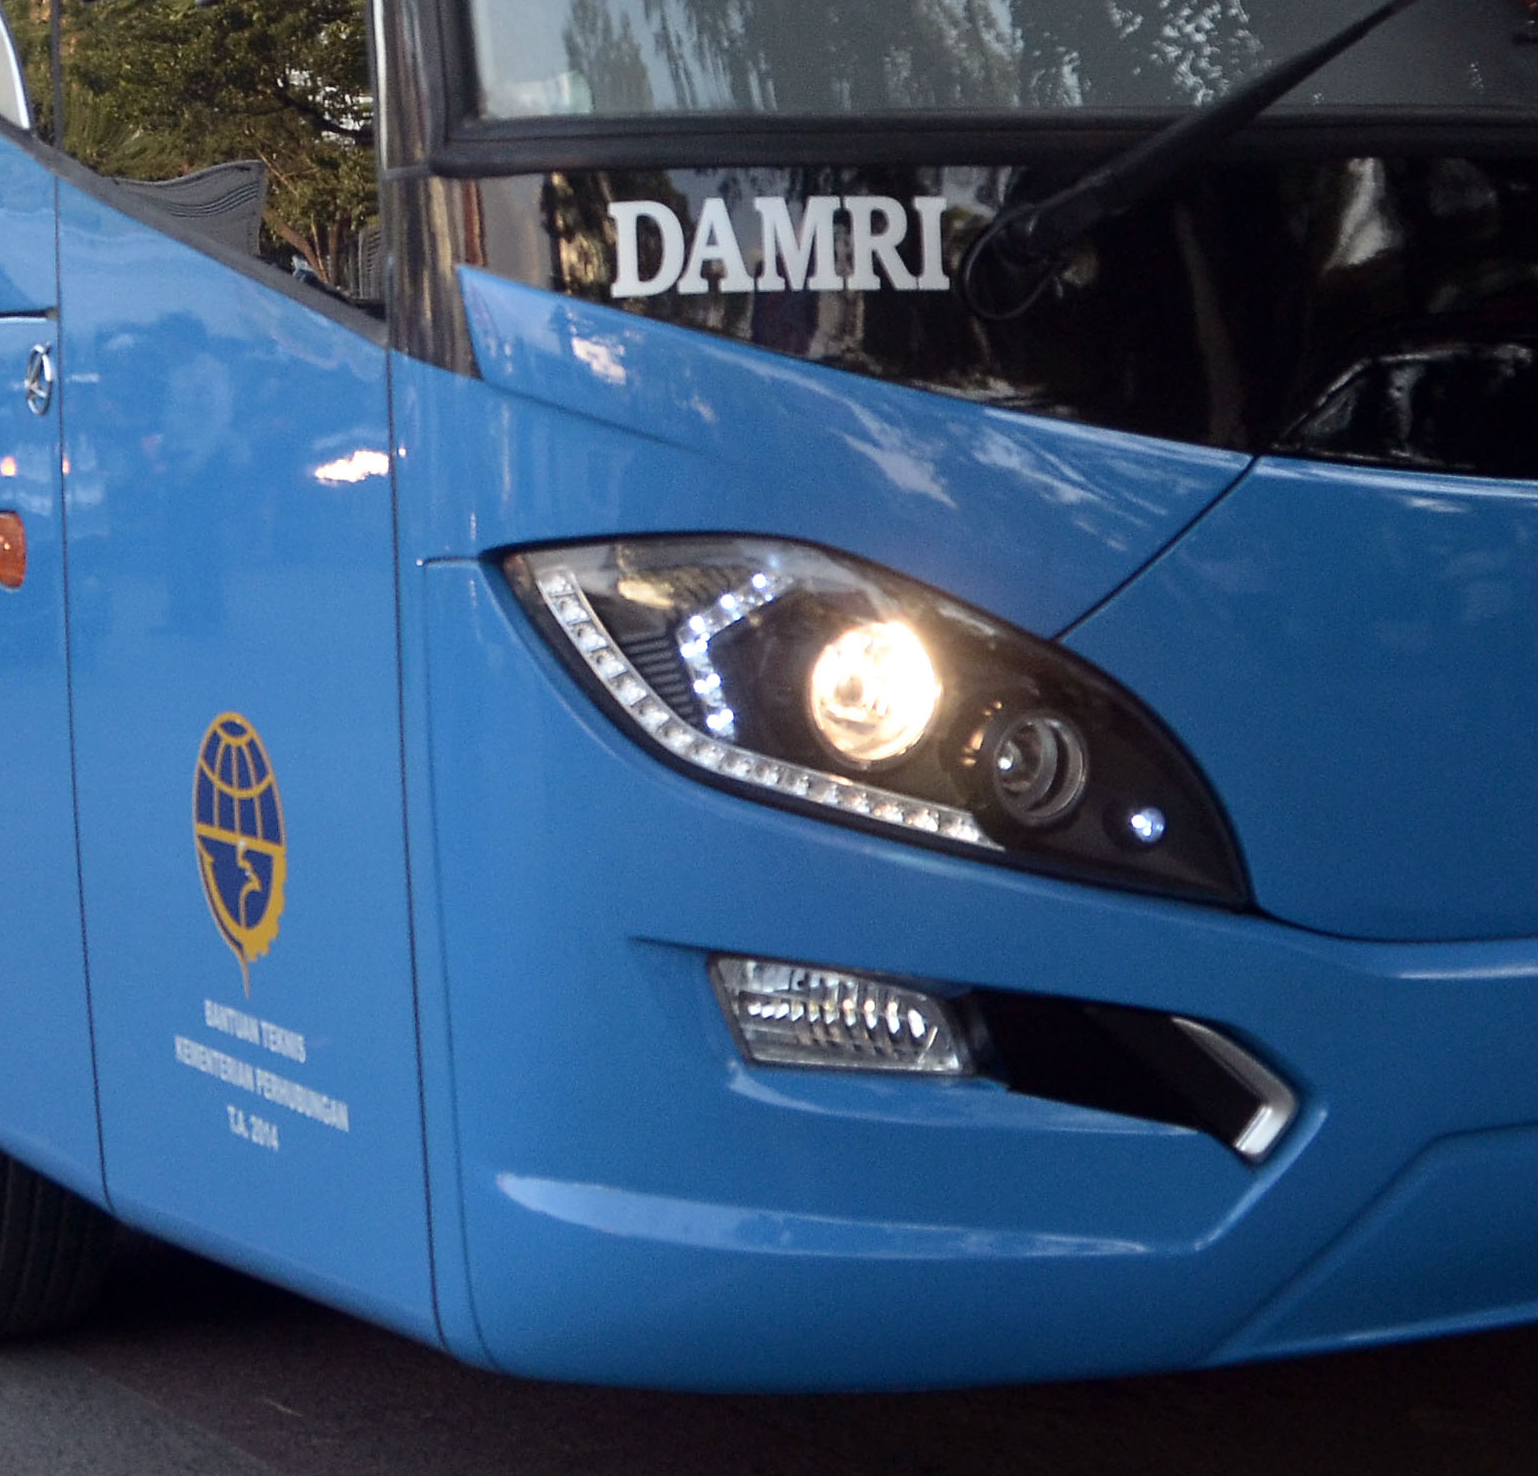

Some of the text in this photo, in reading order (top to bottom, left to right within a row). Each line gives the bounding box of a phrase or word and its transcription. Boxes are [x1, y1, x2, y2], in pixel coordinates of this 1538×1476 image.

[607, 195, 950, 299] DAMRI
[204, 999, 307, 1064] BANTUAN TEKNIS
[174, 1034, 350, 1133] KEMENTERIAN PERHUBUNGAN
[248, 1114, 280, 1152] 2014
